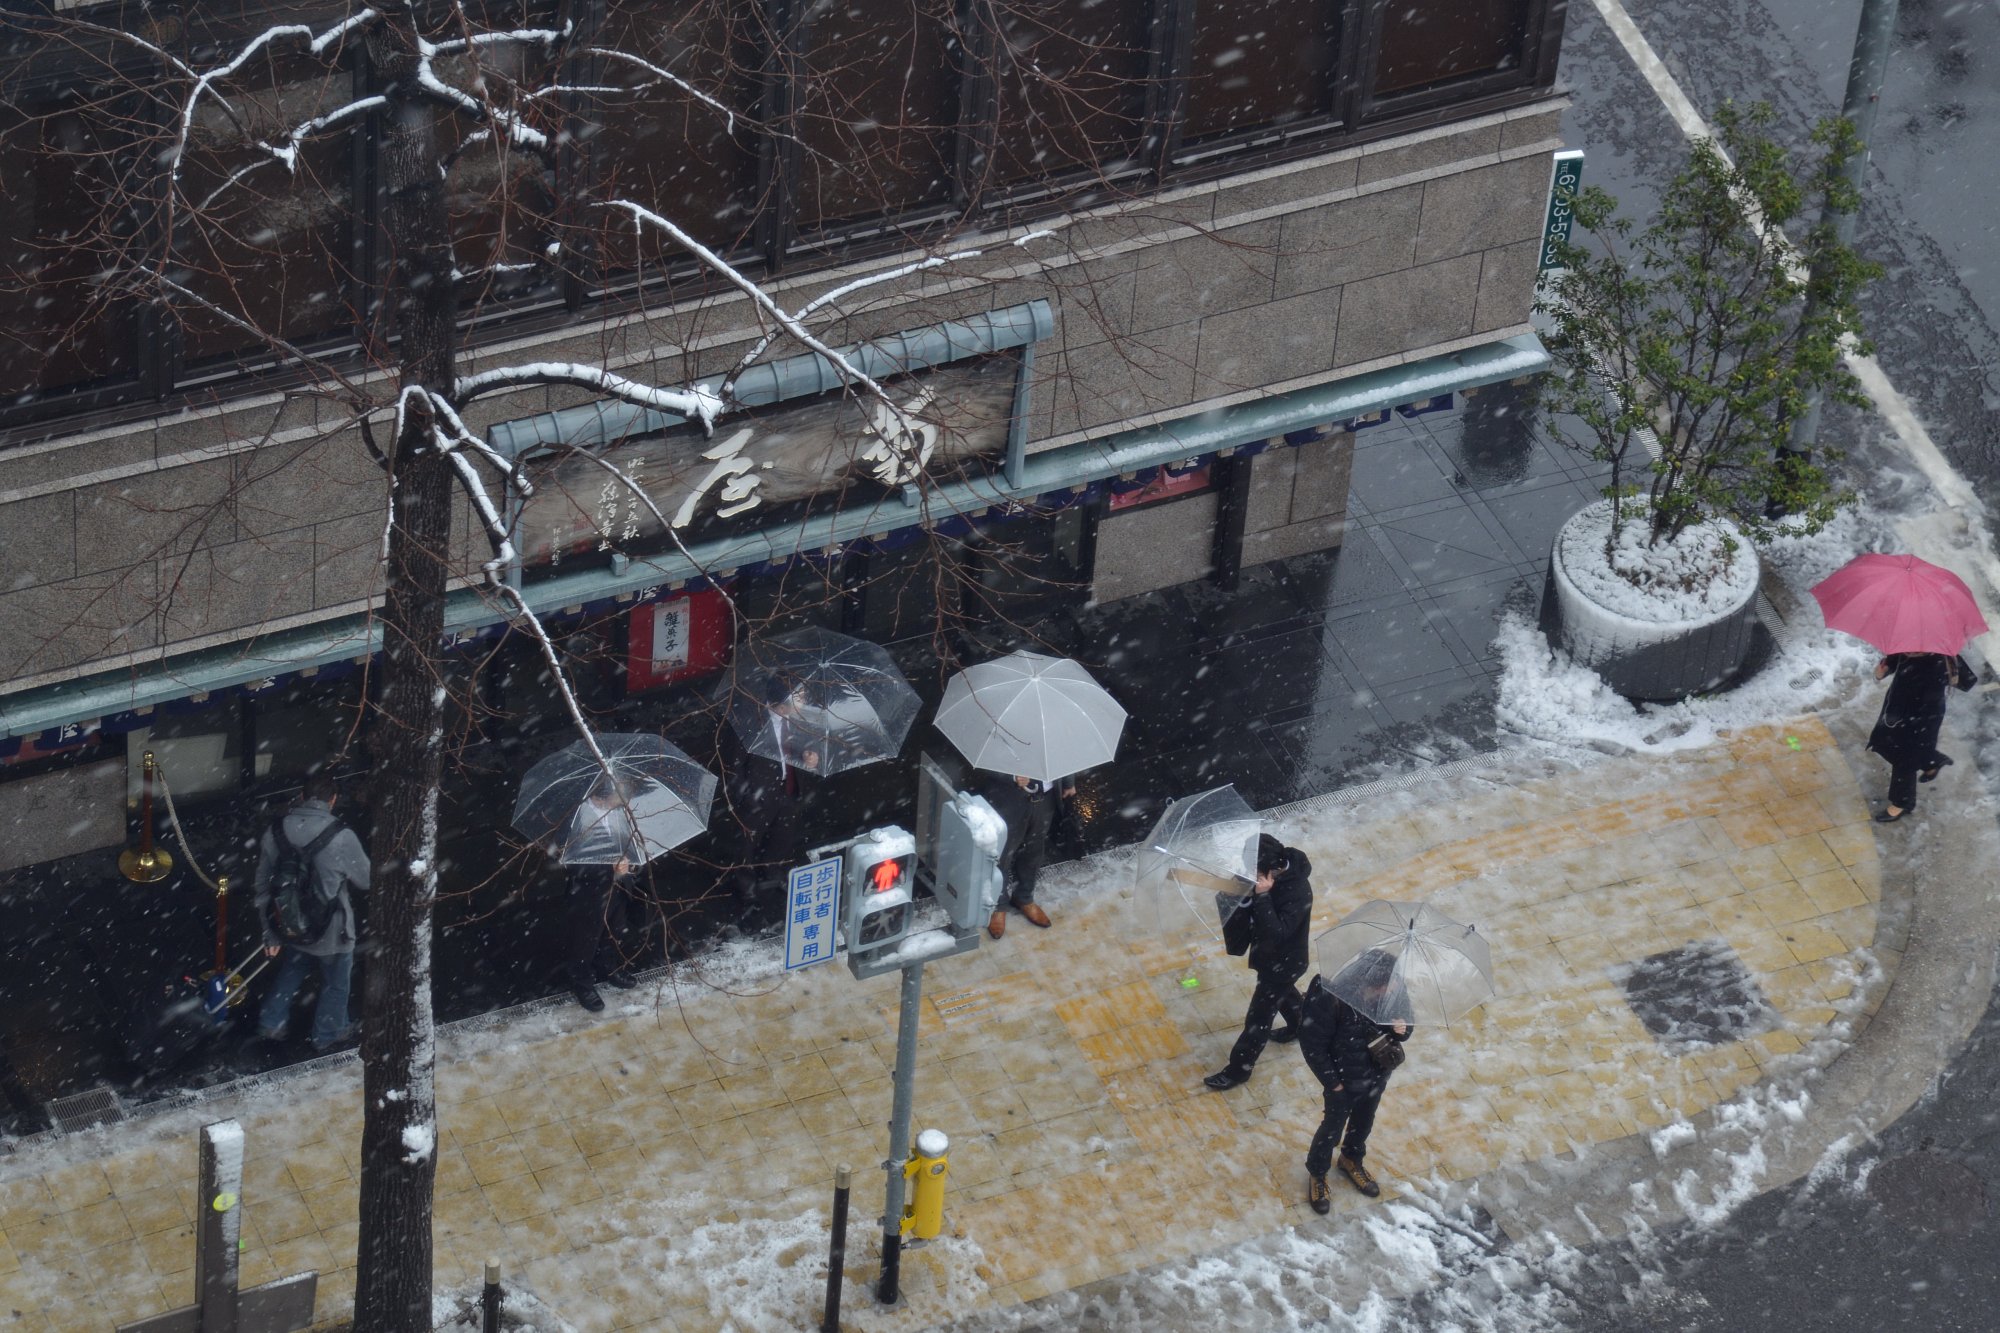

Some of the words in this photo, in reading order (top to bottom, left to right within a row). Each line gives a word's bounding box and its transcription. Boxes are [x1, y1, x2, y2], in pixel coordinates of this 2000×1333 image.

[794, 872, 813, 924] 自転車
[814, 866, 835, 918] 歩行者
[801, 923, 820, 961] 専用
